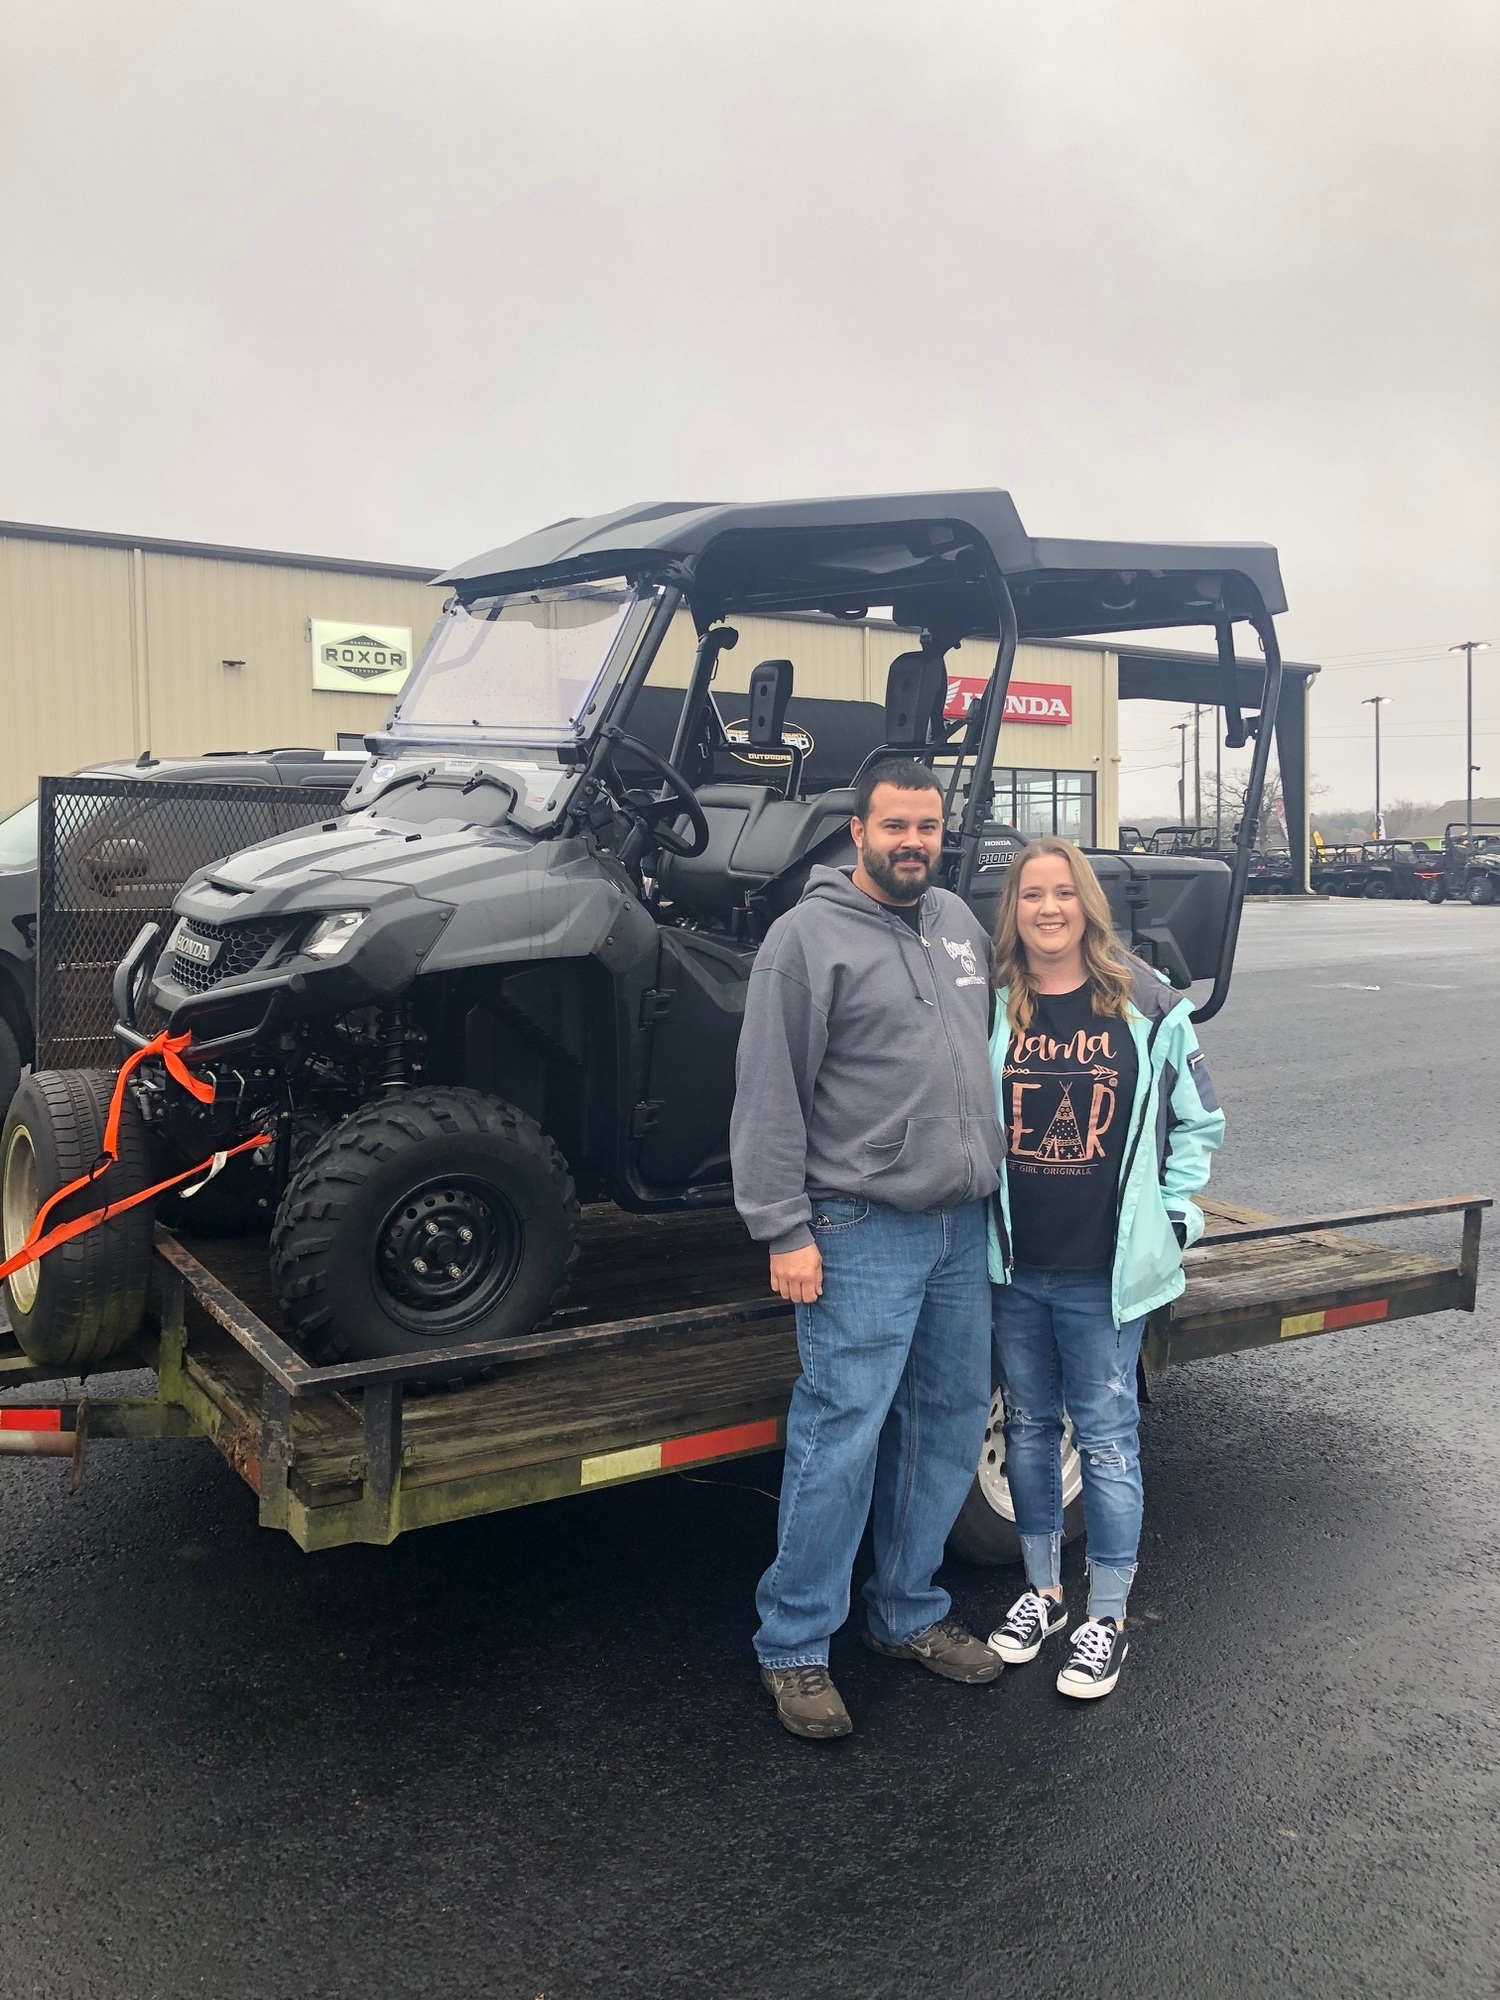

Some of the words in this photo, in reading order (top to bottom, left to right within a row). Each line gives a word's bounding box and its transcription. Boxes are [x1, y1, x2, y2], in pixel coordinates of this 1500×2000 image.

[325, 648, 403, 666] ROXOR
[961, 692, 1070, 717] HNDA
[177, 934, 210, 961] HONDA
[1019, 1164, 1038, 1174] GIRL
